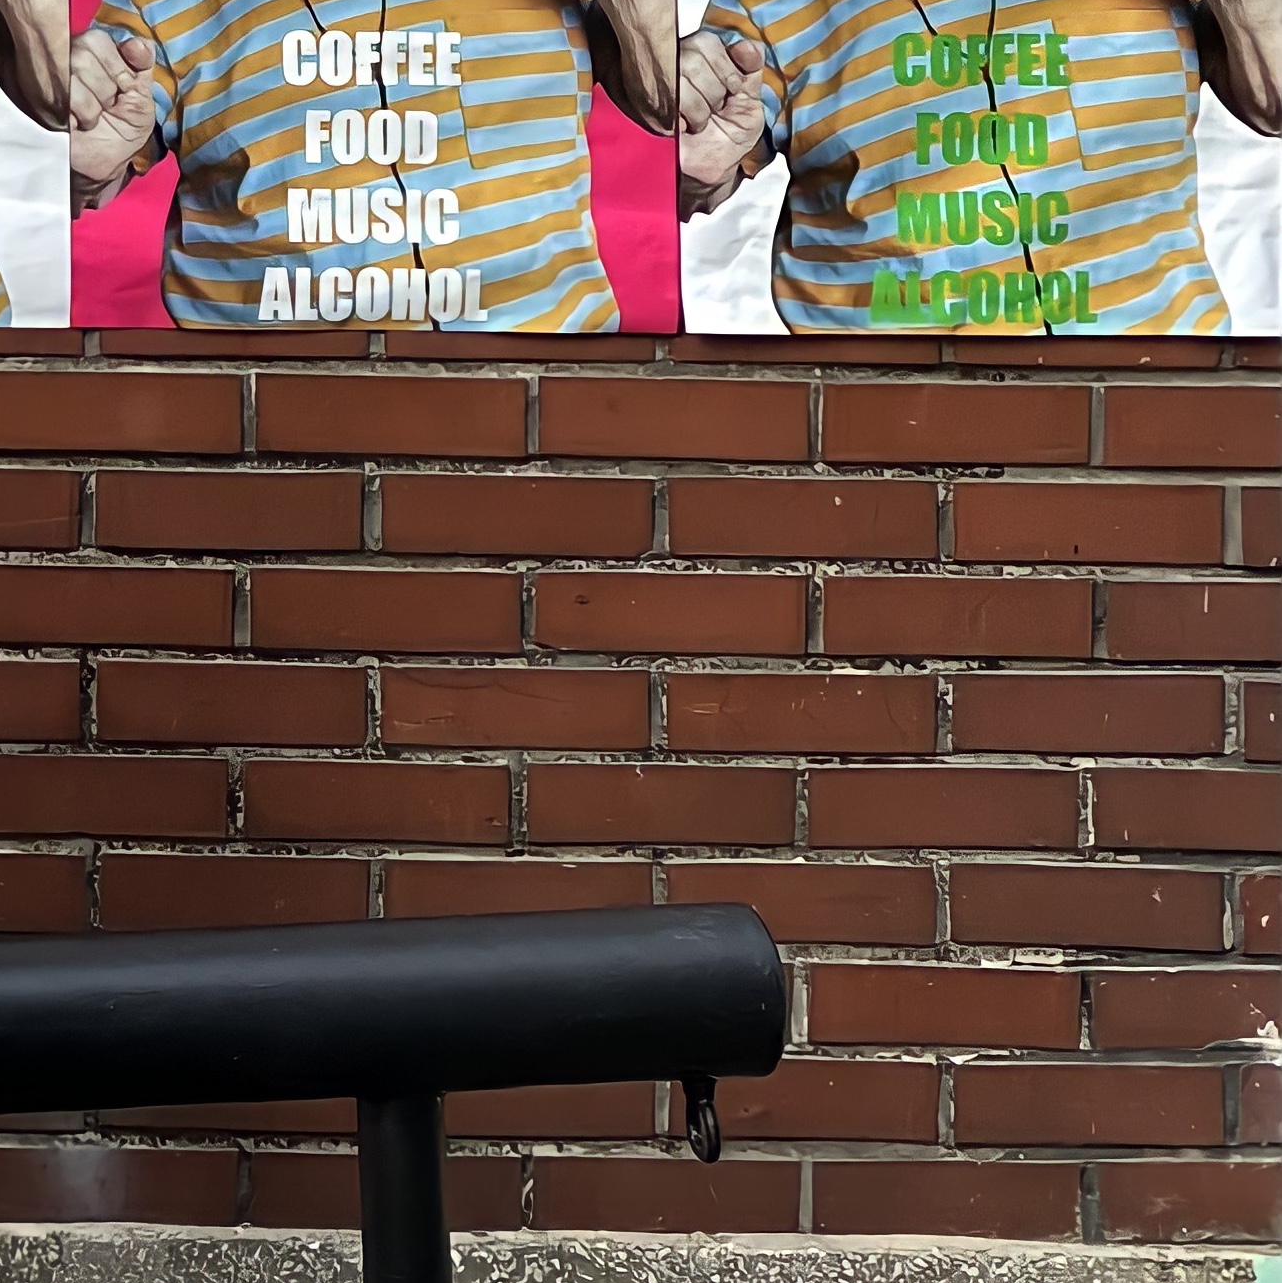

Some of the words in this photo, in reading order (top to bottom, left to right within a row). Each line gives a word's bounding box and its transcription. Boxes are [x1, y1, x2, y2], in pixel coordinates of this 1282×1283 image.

[281, 31, 461, 86] COFFEE
[892, 32, 1070, 88] COFFEE
[303, 110, 437, 164] FOOD
[915, 113, 1048, 165] FOOD
[286, 189, 459, 242] MUSIC
[895, 191, 1068, 246] MUSIC
[258, 267, 487, 321] ALCOHOL
[868, 271, 1097, 327] ALCOHOL
